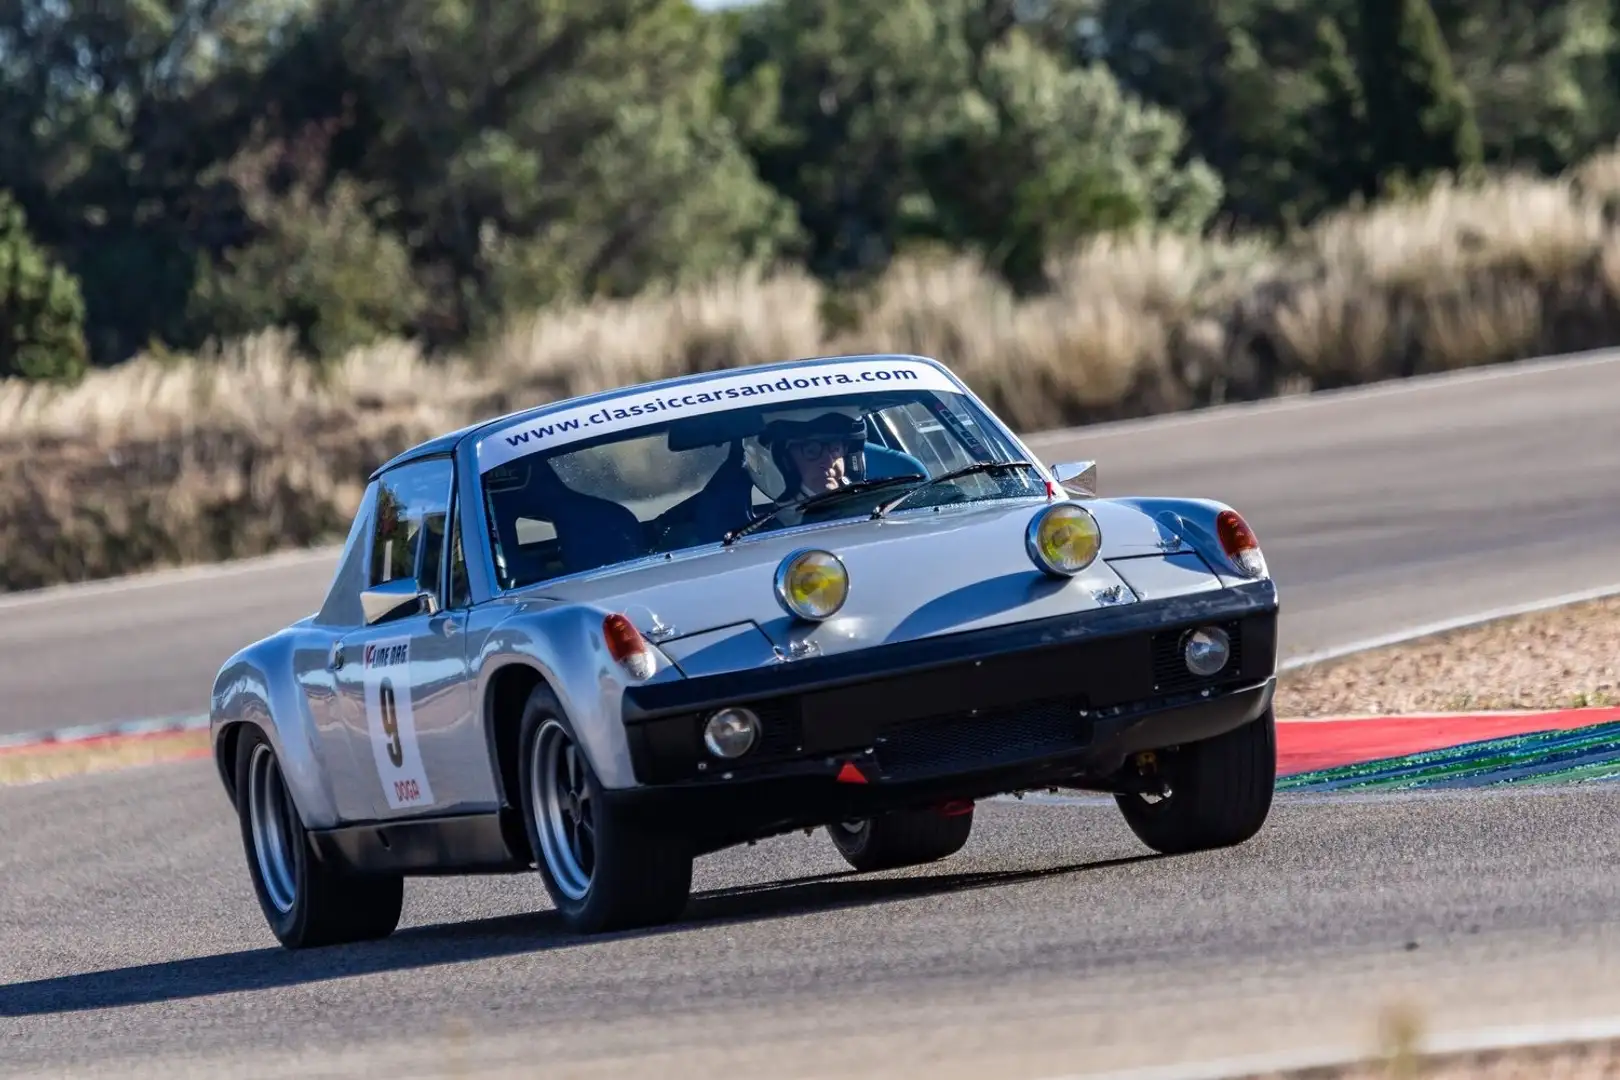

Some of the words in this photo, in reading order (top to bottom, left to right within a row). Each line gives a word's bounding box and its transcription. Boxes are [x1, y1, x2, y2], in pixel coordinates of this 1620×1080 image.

[506, 366, 918, 448] www.classiccarsandorra.com
[390, 643, 408, 666] ORG
[380, 676, 403, 768] 9
[393, 779, 421, 802] DOGA
